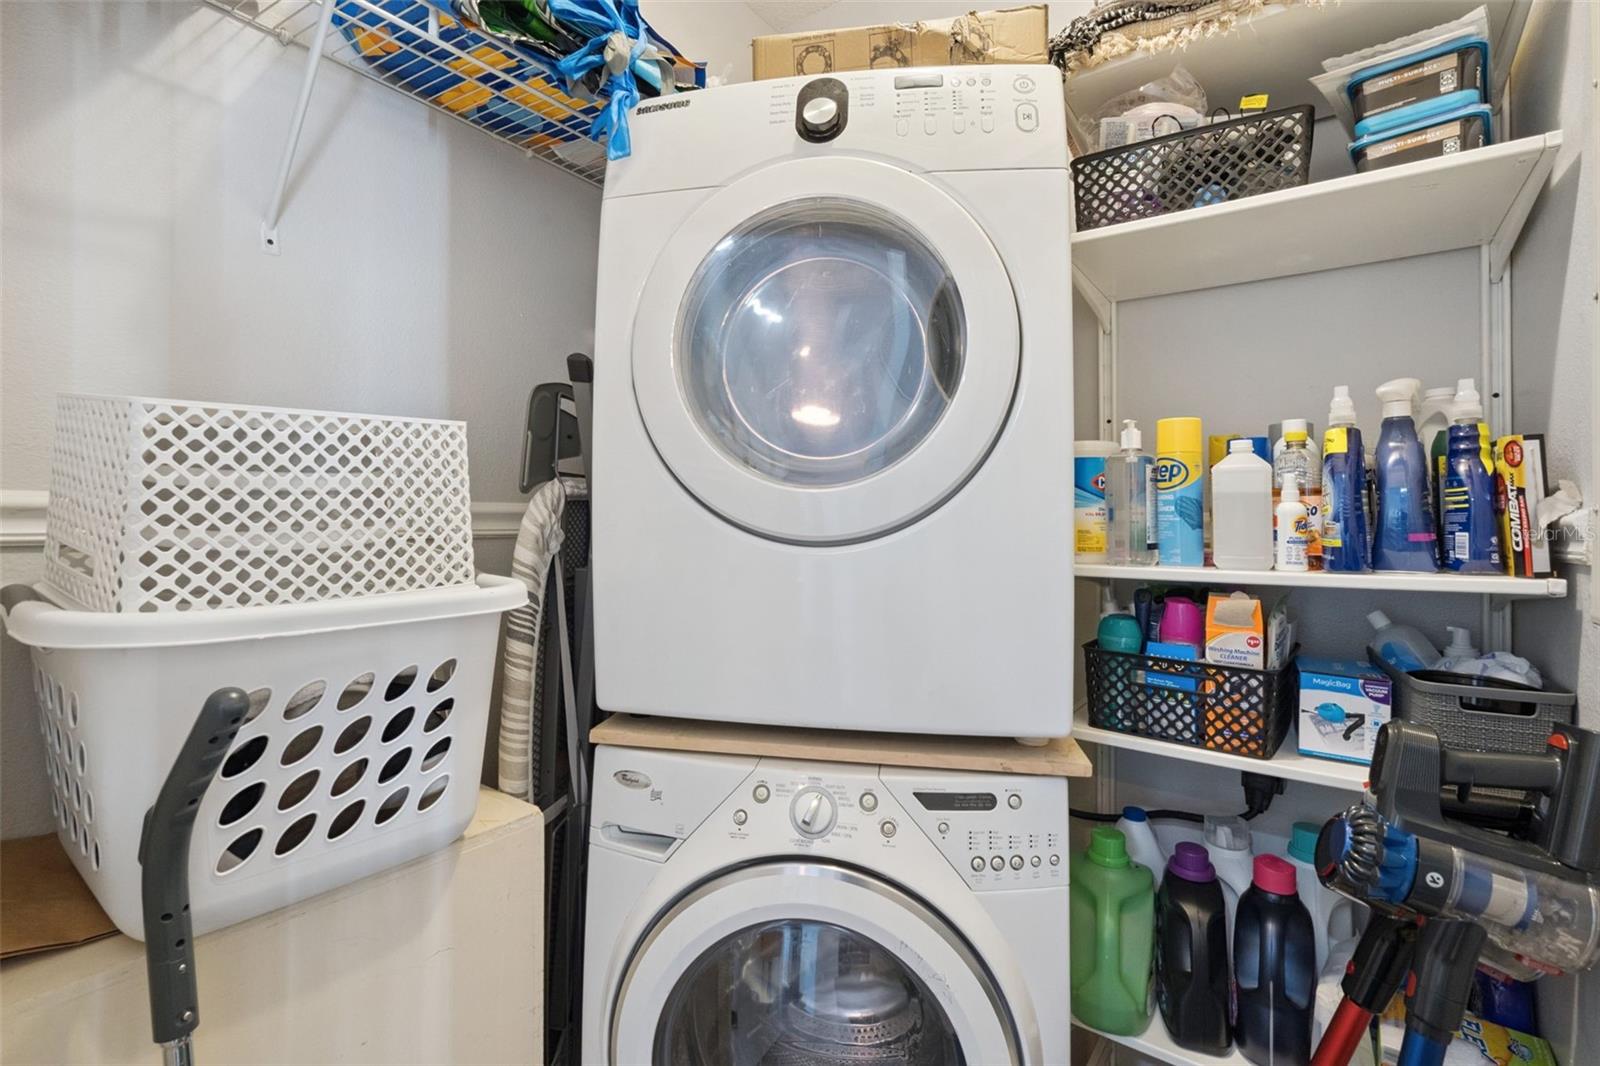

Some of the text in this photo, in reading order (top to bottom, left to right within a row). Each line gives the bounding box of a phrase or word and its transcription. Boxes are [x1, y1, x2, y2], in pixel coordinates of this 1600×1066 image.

[1507, 481, 1524, 552] COMBAT
[1219, 653, 1248, 662] CLEANER
[1312, 677, 1352, 690] MagicBag
